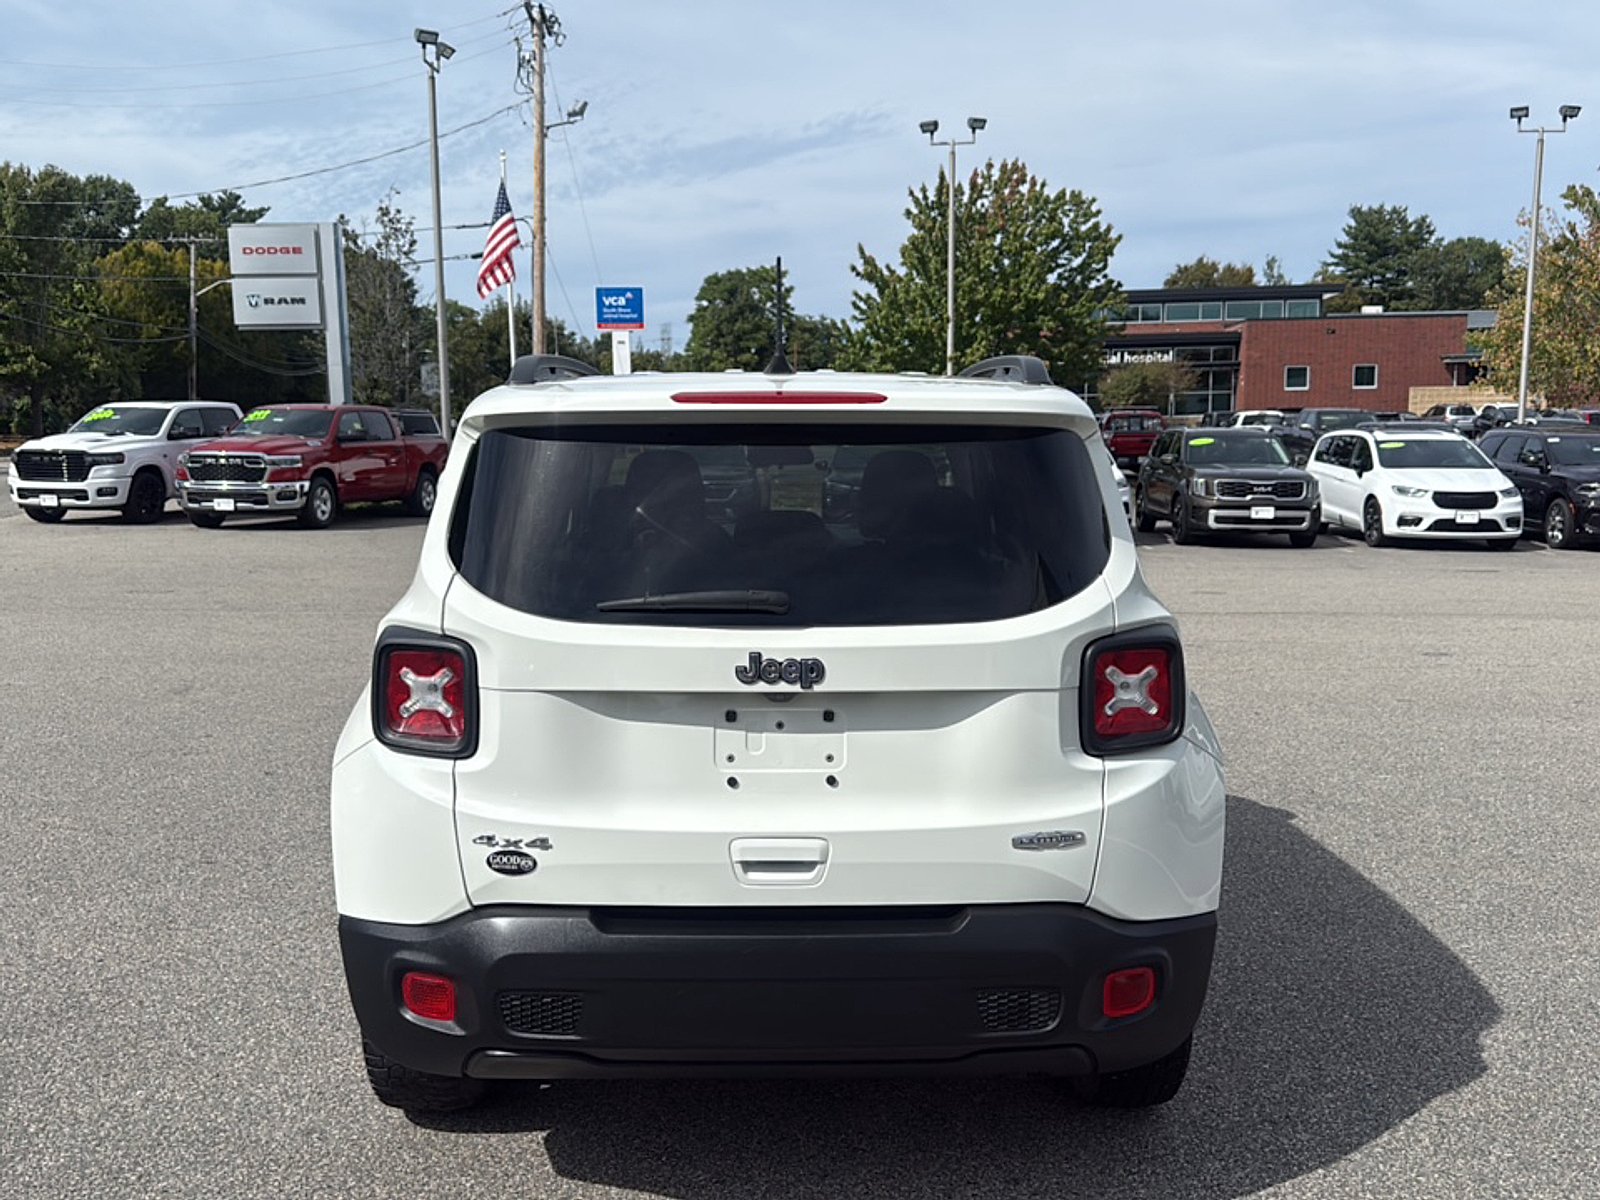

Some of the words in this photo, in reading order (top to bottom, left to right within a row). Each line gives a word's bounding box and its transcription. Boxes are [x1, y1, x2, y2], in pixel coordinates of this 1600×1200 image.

[242, 246, 303, 255] DODGE
[263, 297, 306, 305] RAM
[602, 296, 626, 306] vca
[1123, 350, 1173, 364] hospital
[735, 651, 826, 690] Jeep
[472, 834, 553, 851] 4x4
[489, 853, 520, 865] GOOD
